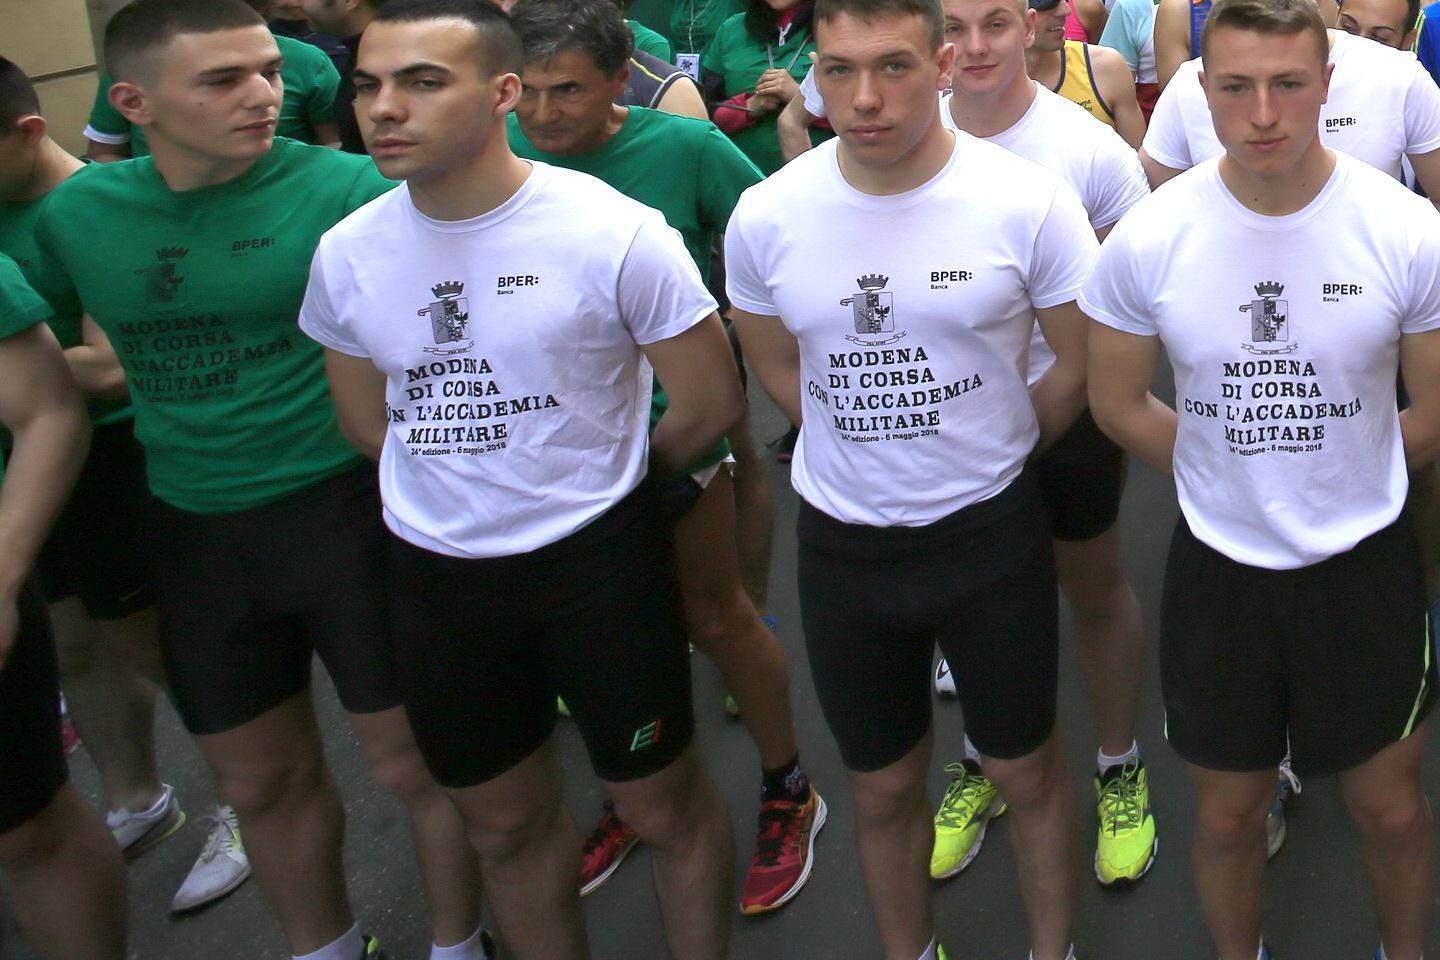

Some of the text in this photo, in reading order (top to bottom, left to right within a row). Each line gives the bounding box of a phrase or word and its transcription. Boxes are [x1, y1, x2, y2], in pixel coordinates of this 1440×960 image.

[1325, 117, 1356, 128] BPER:
[231, 237, 276, 252] BPER:
[497, 275, 540, 288] BPER:
[930, 270, 973, 283] BPER:
[1322, 283, 1363, 295] BPER:
[117, 315, 226, 337] MODENA
[122, 330, 235, 355] DI CORSA
[828, 346, 929, 369] MODENA
[405, 358, 493, 382] MODENA
[828, 367, 936, 390] DI CORSA
[1222, 359, 1317, 378] MODENA
[405, 380, 501, 401] DI CORSA
[808, 373, 983, 411] CON L'ACCADEMIA
[1221, 381, 1322, 400] DI CORSA
[416, 394, 560, 421] L'ACCADEMIA
[1184, 397, 1362, 424] CON L'ACCADEMIA
[833, 409, 941, 432] MILITARE
[406, 422, 508, 444] MILITARE
[851, 434, 880, 443] edizione
[885, 433, 891, 441] 6
[892, 431, 919, 441] maggio
[920, 429, 939, 437] 2018
[1224, 424, 1325, 446] MILITARE
[422, 447, 451, 456] edizione
[457, 446, 463, 454] 6
[463, 446, 485, 456] maggio
[486, 442, 507, 452] 2018
[1271, 444, 1276, 452] 6
[1277, 444, 1304, 453] maggio
[1305, 443, 1322, 452] 2018
